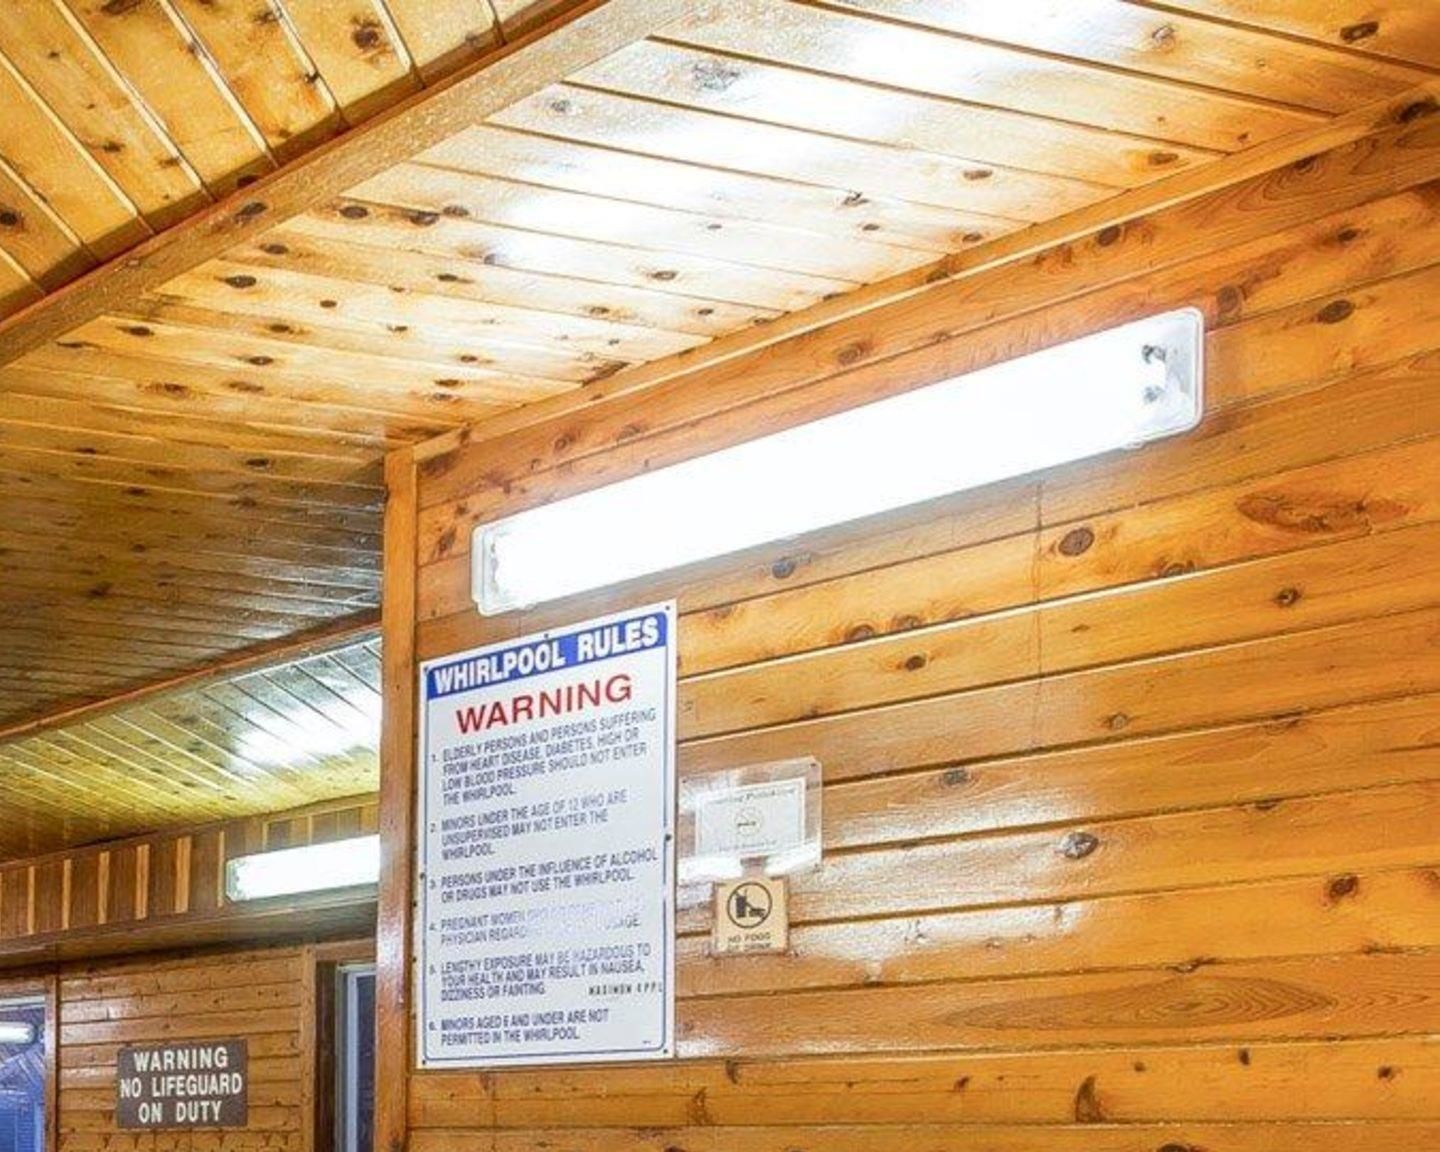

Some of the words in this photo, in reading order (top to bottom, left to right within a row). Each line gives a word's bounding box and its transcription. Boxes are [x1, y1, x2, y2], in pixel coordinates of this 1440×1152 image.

[433, 640, 566, 694] WHIRLPOOL
[576, 616, 659, 662] RULES
[456, 673, 632, 734] WARNING
[442, 741, 482, 762] ELDERLY
[483, 733, 526, 754] PERSONS
[529, 728, 550, 746] AND
[551, 719, 598, 741] PERSONS
[599, 708, 656, 732] SUFFERING
[442, 758, 468, 776] FROM
[470, 753, 500, 771] HEART
[596, 730, 622, 747] HIGH
[624, 726, 640, 742] OR
[442, 775, 462, 792] LOW
[464, 769, 496, 788] BLOOD
[497, 760, 546, 782] PRESSURE
[548, 752, 588, 773] SHOULD
[590, 748, 610, 765] NOT
[612, 741, 647, 761] ENTER
[442, 790, 460, 806] THE
[442, 814, 476, 832] MINORS
[478, 809, 508, 826] UNDER
[510, 805, 528, 821] THE
[530, 802, 550, 817] AGE
[582, 793, 604, 809] WHO
[606, 789, 628, 805] ARE
[442, 824, 510, 846] UNSUPERVISED
[512, 821, 531, 836] MAY
[534, 818, 554, 833] NOT
[554, 813, 588, 829] ENTER
[590, 809, 608, 824] THE
[441, 871, 483, 889] PERSONS
[484, 867, 516, 883] UNDER
[518, 864, 536, 879] THE
[538, 856, 592, 876] INFLUENCE
[594, 854, 608, 868] OF
[610, 848, 658, 866] ALCOHOL
[442, 890, 454, 904] OR
[456, 886, 488, 902] DRUGS
[488, 883, 508, 898] MAY
[510, 881, 530, 895] NOT
[531, 878, 550, 893] USE
[552, 875, 571, 890] THE
[442, 914, 489, 930] PREGNANT
[490, 910, 526, 925] WOMEN
[442, 929, 487, 946] PHYSICIAN
[442, 958, 481, 974] LENGTHY
[484, 953, 532, 971] EXPOSURE
[535, 951, 554, 966] MAY
[557, 950, 570, 964] BE
[572, 944, 634, 963] HAZARDOUS
[637, 942, 652, 957] TO
[442, 973, 466, 987] YOUR
[468, 970, 504, 985] HEALTH
[506, 968, 524, 982] AND
[526, 966, 546, 980] MAY
[549, 963, 586, 978] RESULT
[588, 962, 598, 975] IN
[442, 986, 485, 1002] DIZZINESS
[486, 985, 500, 998] OR
[441, 1017, 474, 1031] MINORS
[476, 1015, 502, 1029] AGED
[510, 1013, 530, 1026] AND
[532, 1011, 564, 1025] UNDER
[567, 1009, 586, 1022] ARE
[588, 1008, 609, 1021] NOT
[441, 1032, 490, 1046] PERMITTED
[492, 1031, 502, 1044] IN
[503, 1030, 520, 1043] THE
[134, 1047, 229, 1072] WARNING
[120, 1077, 142, 1098] NO
[152, 1073, 243, 1097] LIFEGUARD
[138, 1102, 163, 1123] ON
[176, 1100, 222, 1123] DUTY
